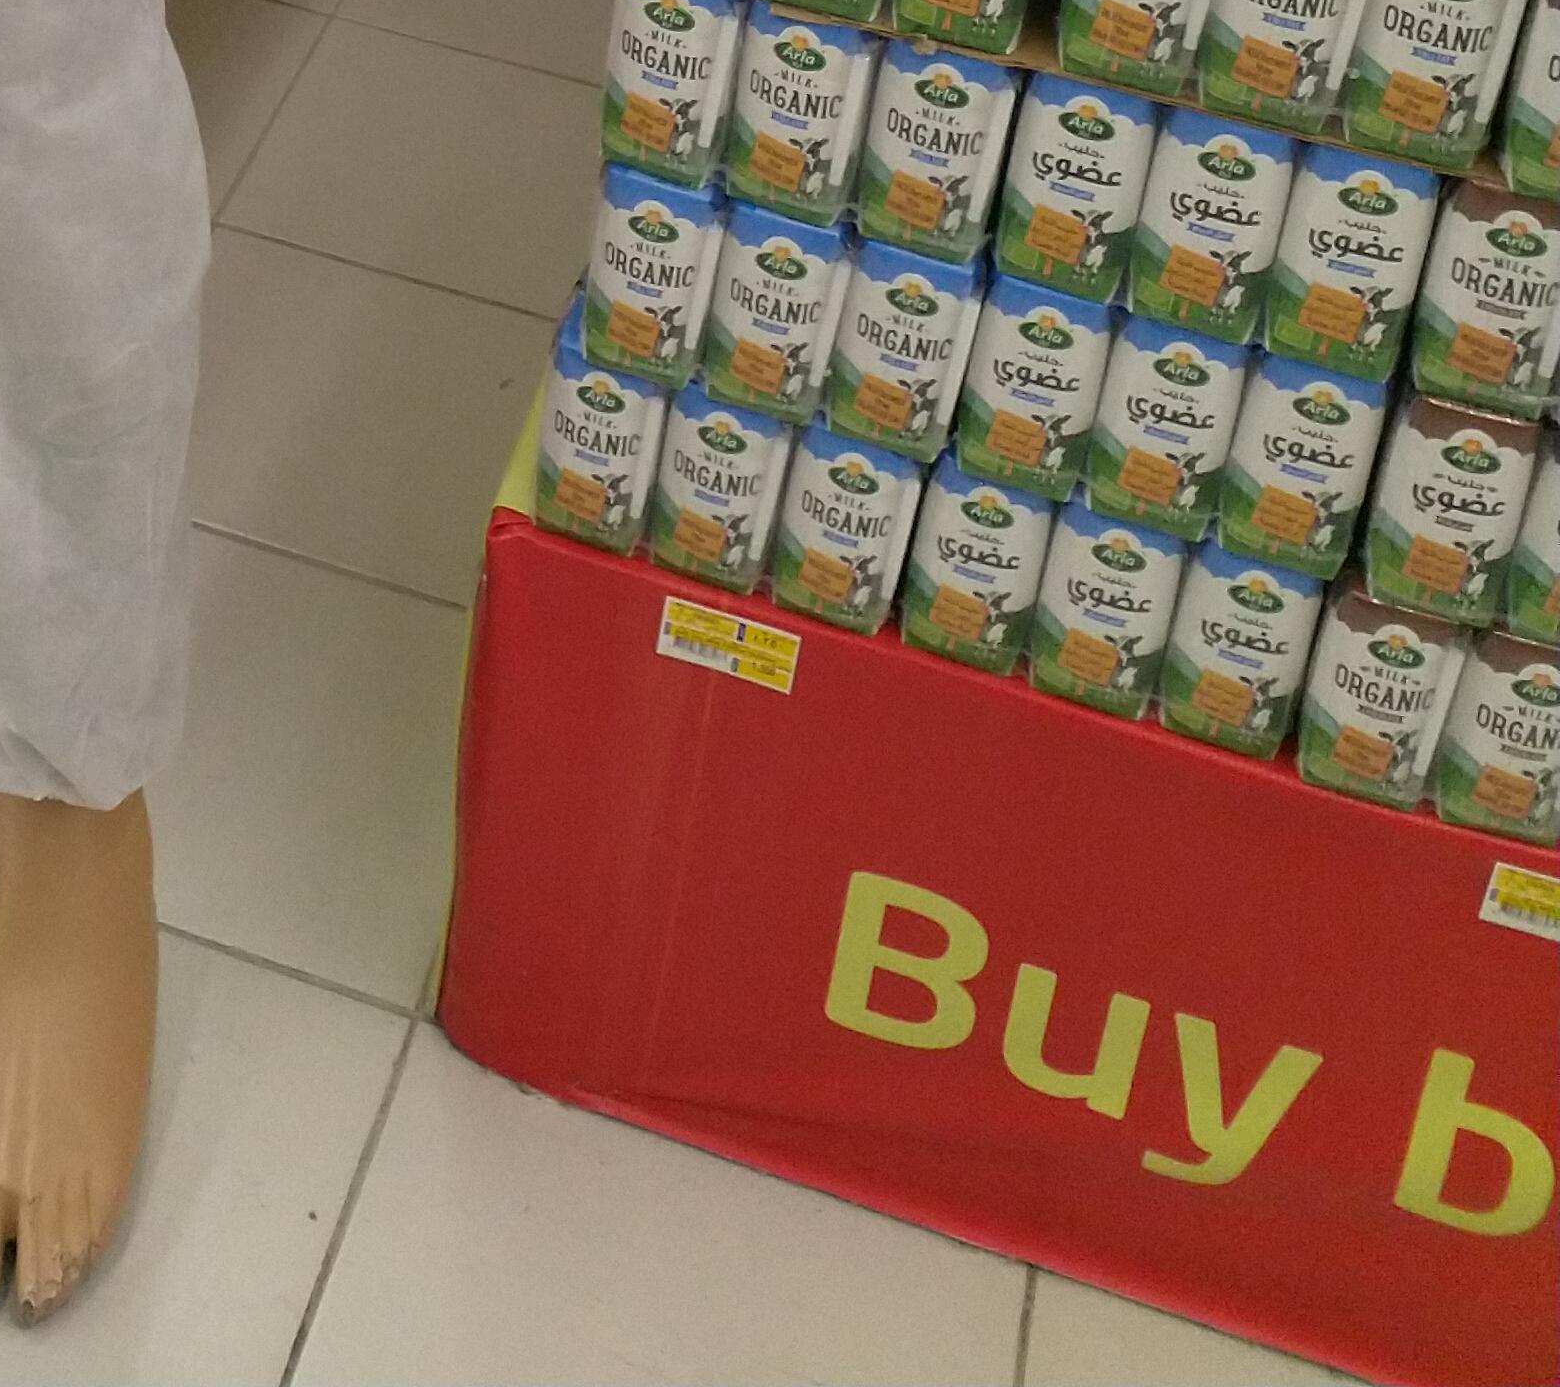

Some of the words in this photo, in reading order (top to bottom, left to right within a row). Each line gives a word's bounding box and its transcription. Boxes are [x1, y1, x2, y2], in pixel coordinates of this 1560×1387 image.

[1383, 3, 1494, 55] ORGANIC
[621, 29, 712, 81] ORGANIC
[887, 107, 984, 158] ORGANIC
[1170, 189, 1262, 228] عضوي
[604, 240, 696, 290] ORGANIC
[1308, 225, 1404, 265] عضوي
[856, 311, 955, 363] ORGANIC
[553, 409, 641, 458] ORGANIC
[1263, 431, 1354, 470] عضوي
[801, 488, 892, 539] ORGANIC
[1066, 576, 1153, 615] عضوي
[823, 869, 1324, 1187] Buy
